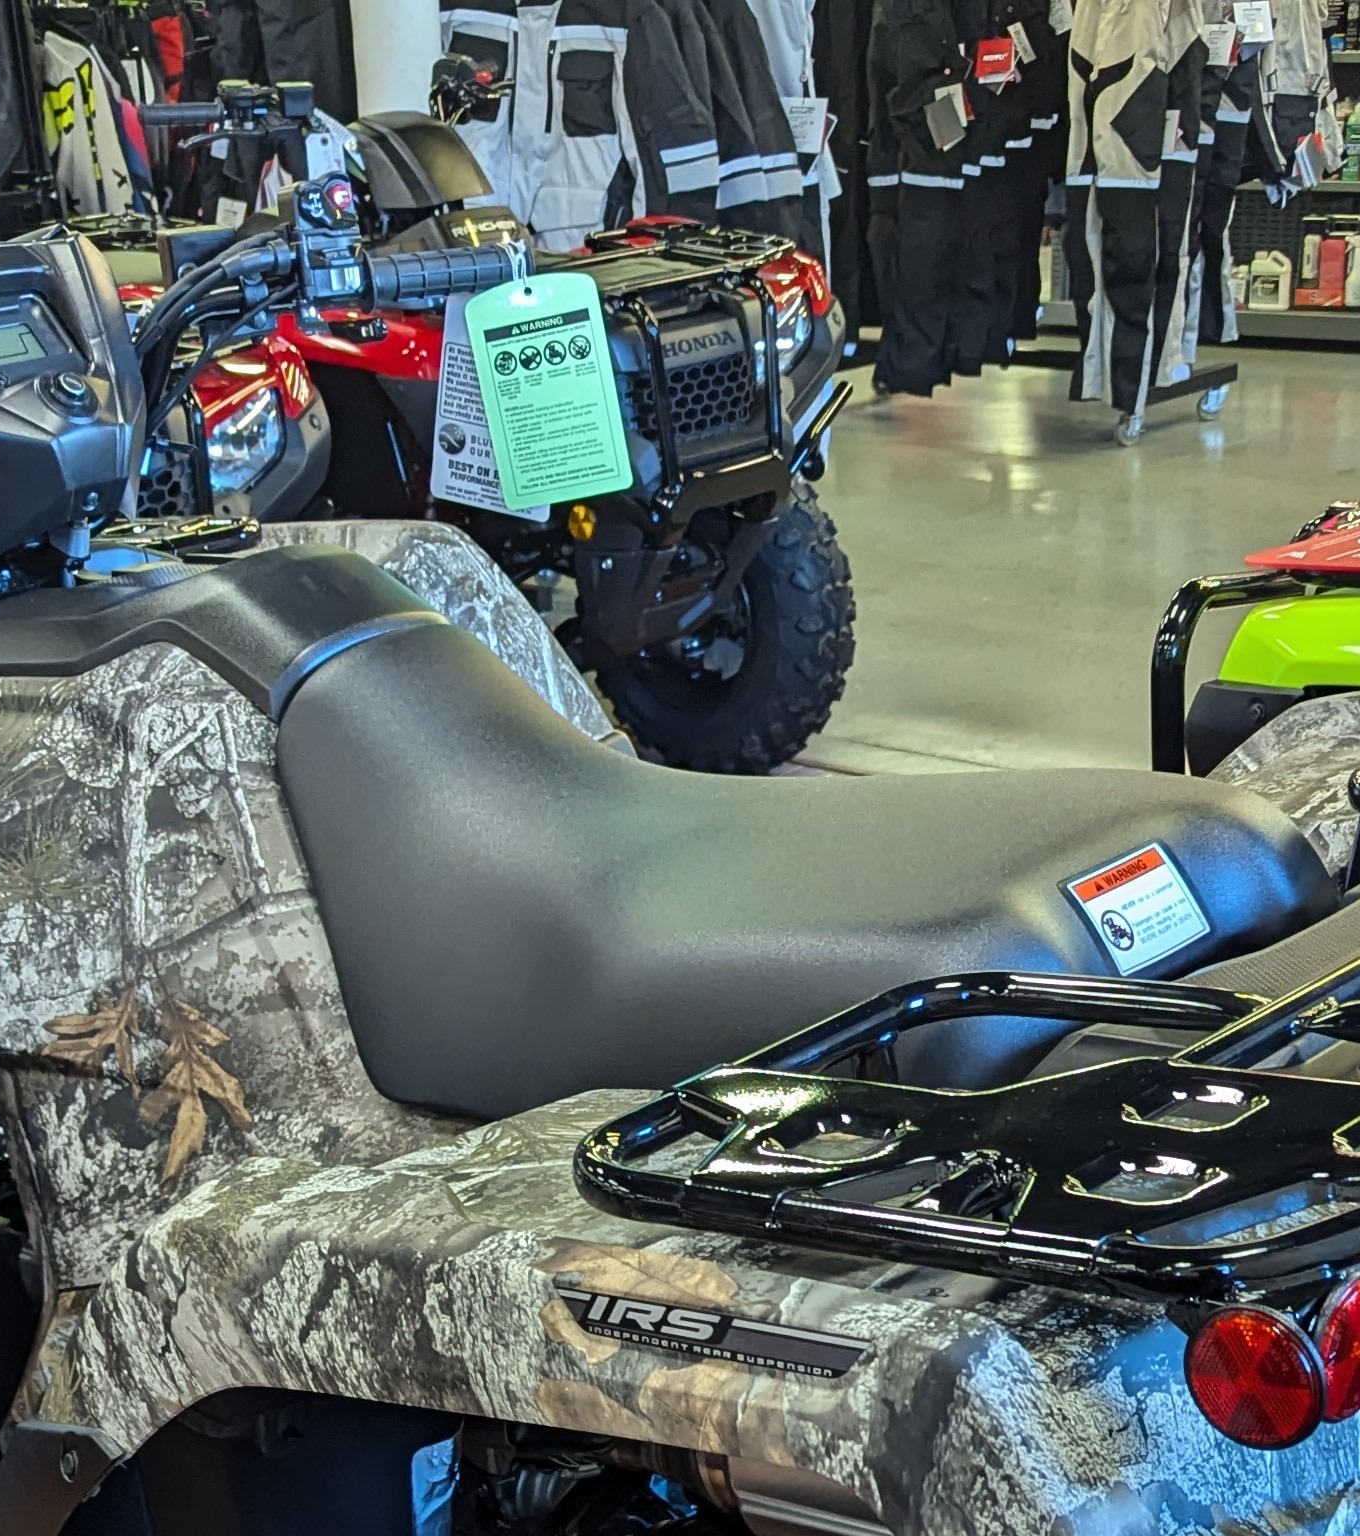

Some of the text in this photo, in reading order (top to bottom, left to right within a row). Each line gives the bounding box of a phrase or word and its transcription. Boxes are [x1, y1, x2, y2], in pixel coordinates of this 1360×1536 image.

[520, 316, 563, 332] WARNING
[661, 330, 737, 358] HONDA
[469, 447, 491, 459] OUR
[448, 459, 490, 477] BEST ON
[450, 471, 499, 489] PERFORMANCE
[1101, 859, 1147, 888] WARNING
[588, 1296, 721, 1342] IRS
[588, 1325, 833, 1377] INDEPENDENT REAR SUSPENSION
